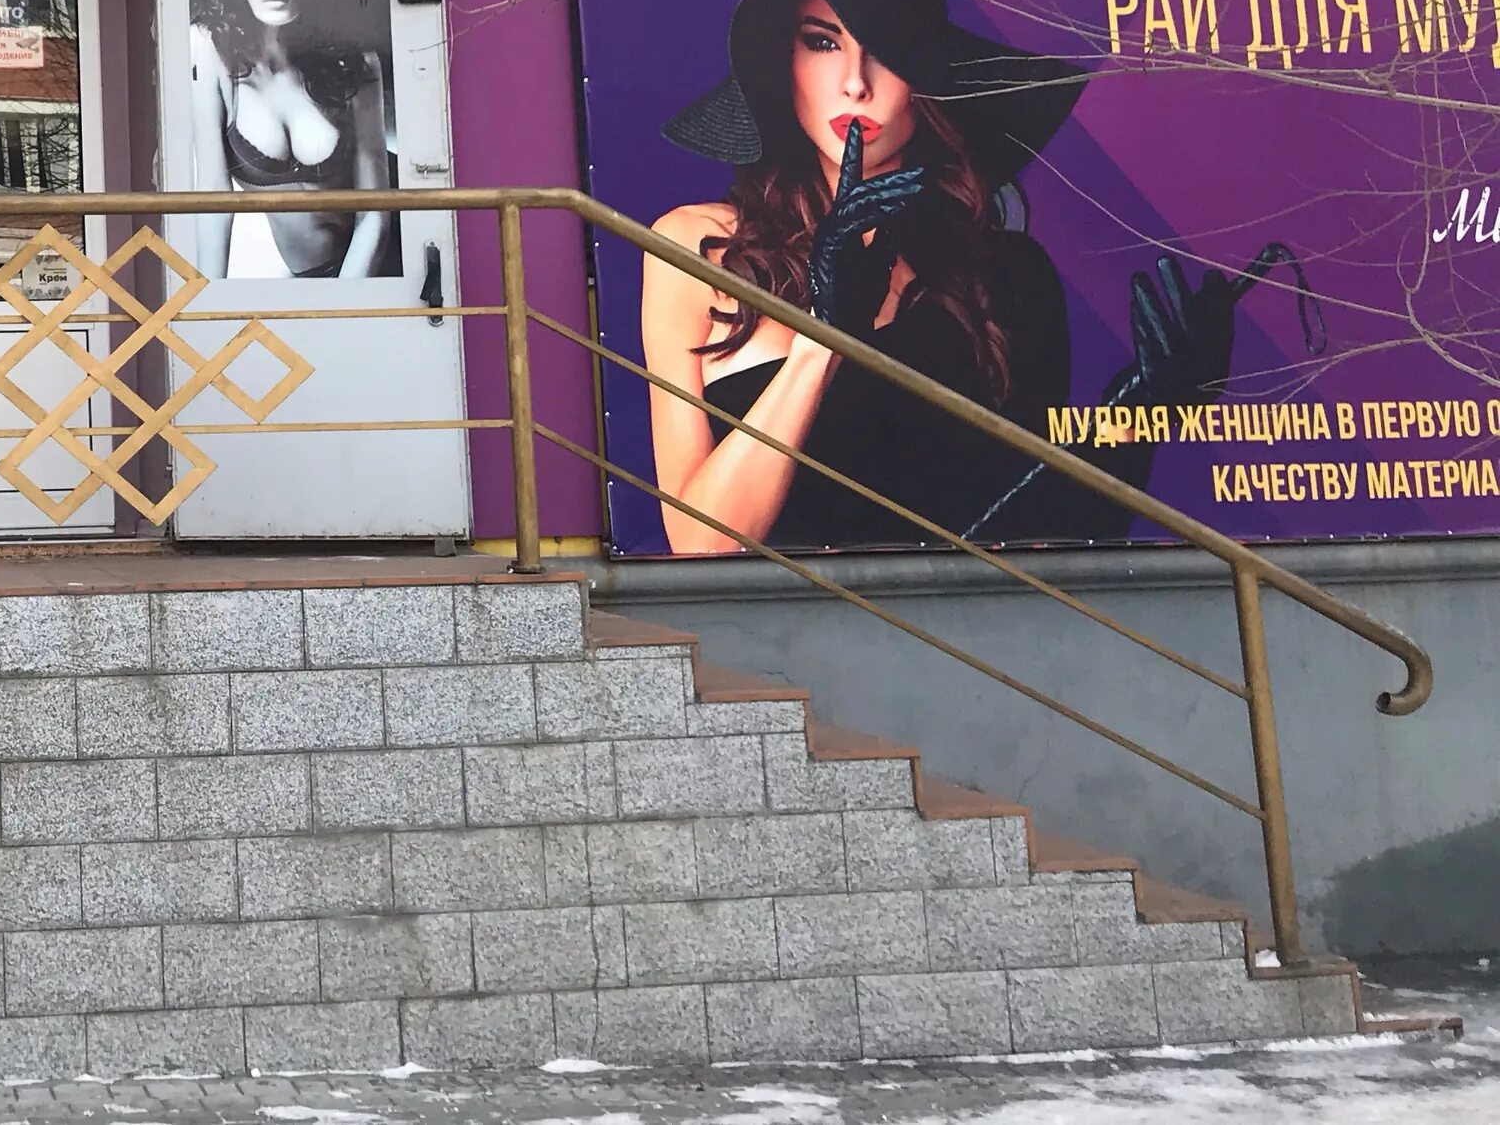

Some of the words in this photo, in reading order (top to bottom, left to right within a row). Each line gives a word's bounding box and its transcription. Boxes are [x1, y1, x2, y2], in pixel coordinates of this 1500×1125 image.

[1047, 404, 1171, 449] МУДРАЯ
[1176, 402, 1332, 446] ЖЕНЩИНА
[1336, 402, 1357, 440] В
[1362, 400, 1481, 440] ПЕРВУЮ
[1211, 462, 1358, 502] КАЧЕСТВУ
